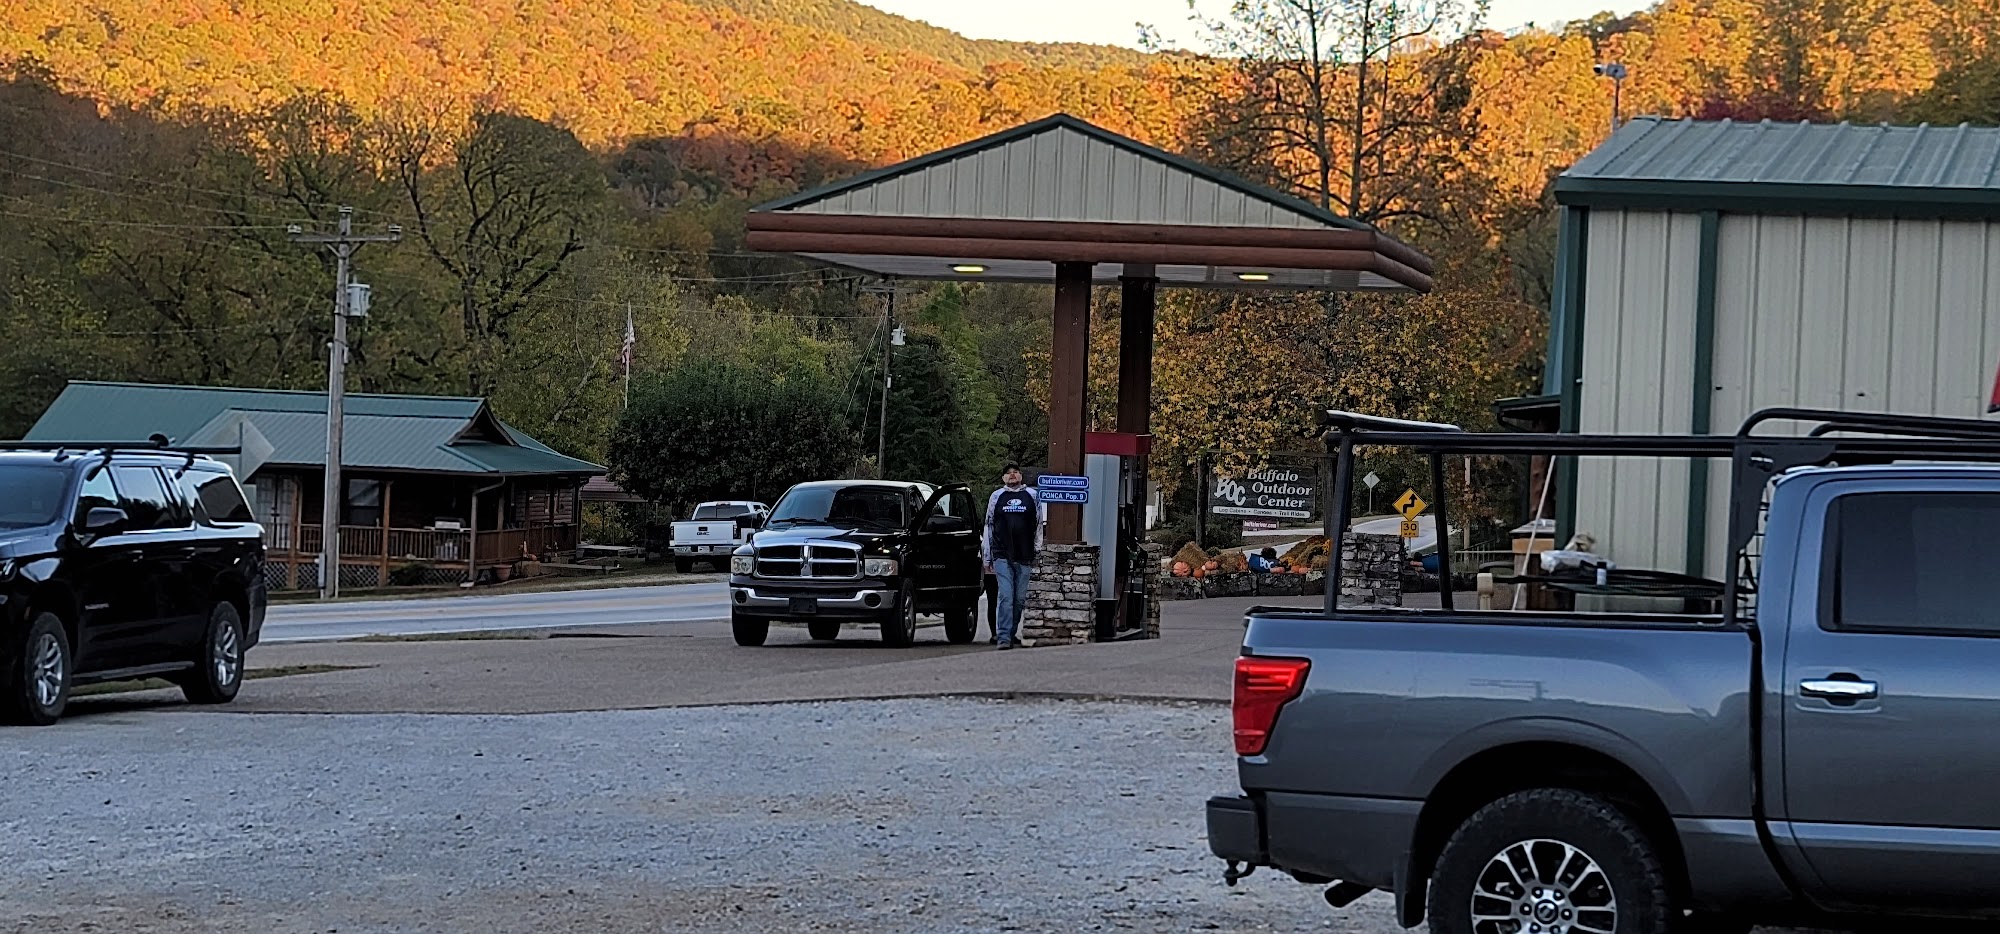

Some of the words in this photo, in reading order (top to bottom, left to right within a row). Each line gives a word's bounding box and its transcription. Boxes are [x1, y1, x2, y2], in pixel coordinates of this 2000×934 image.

[1041, 477, 1085, 486] buffaloriver.com
[1247, 468, 1299, 483] Buffalo
[1214, 478, 1246, 506] BOC
[1252, 481, 1313, 496] Outdoor
[1065, 493, 1079, 501] Pop.
[1257, 494, 1306, 508] Center
[1403, 523, 1417, 531] 30
[1259, 556, 1274, 570] BOC
